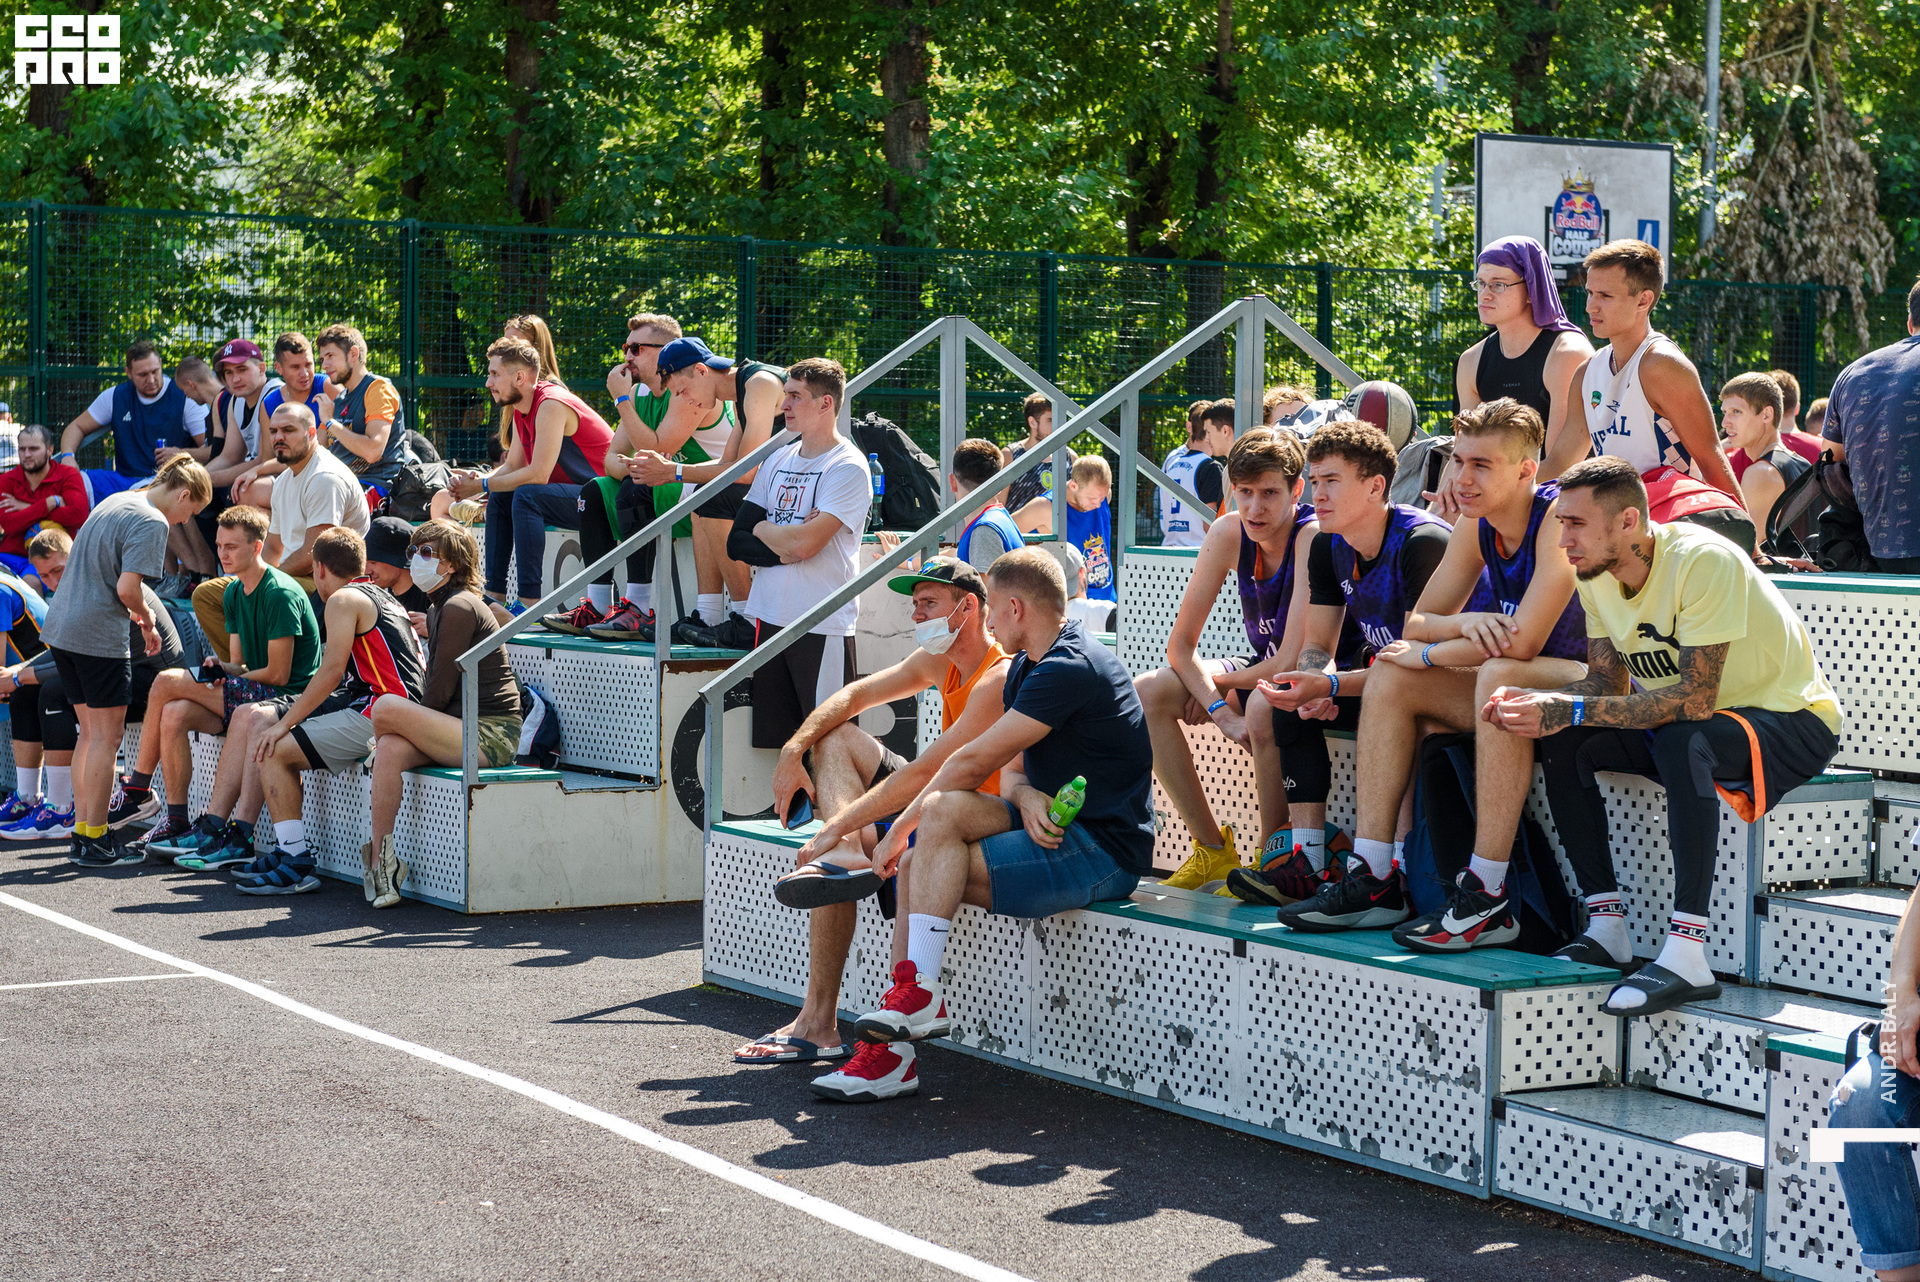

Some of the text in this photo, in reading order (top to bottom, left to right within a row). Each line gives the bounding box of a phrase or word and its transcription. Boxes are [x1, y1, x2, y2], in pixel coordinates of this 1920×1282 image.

[1556, 213, 1600, 231] Red Bull
[1565, 230, 1590, 240] HALF
[1685, 494, 1710, 506] 24
[1617, 649, 1680, 679] UMA
